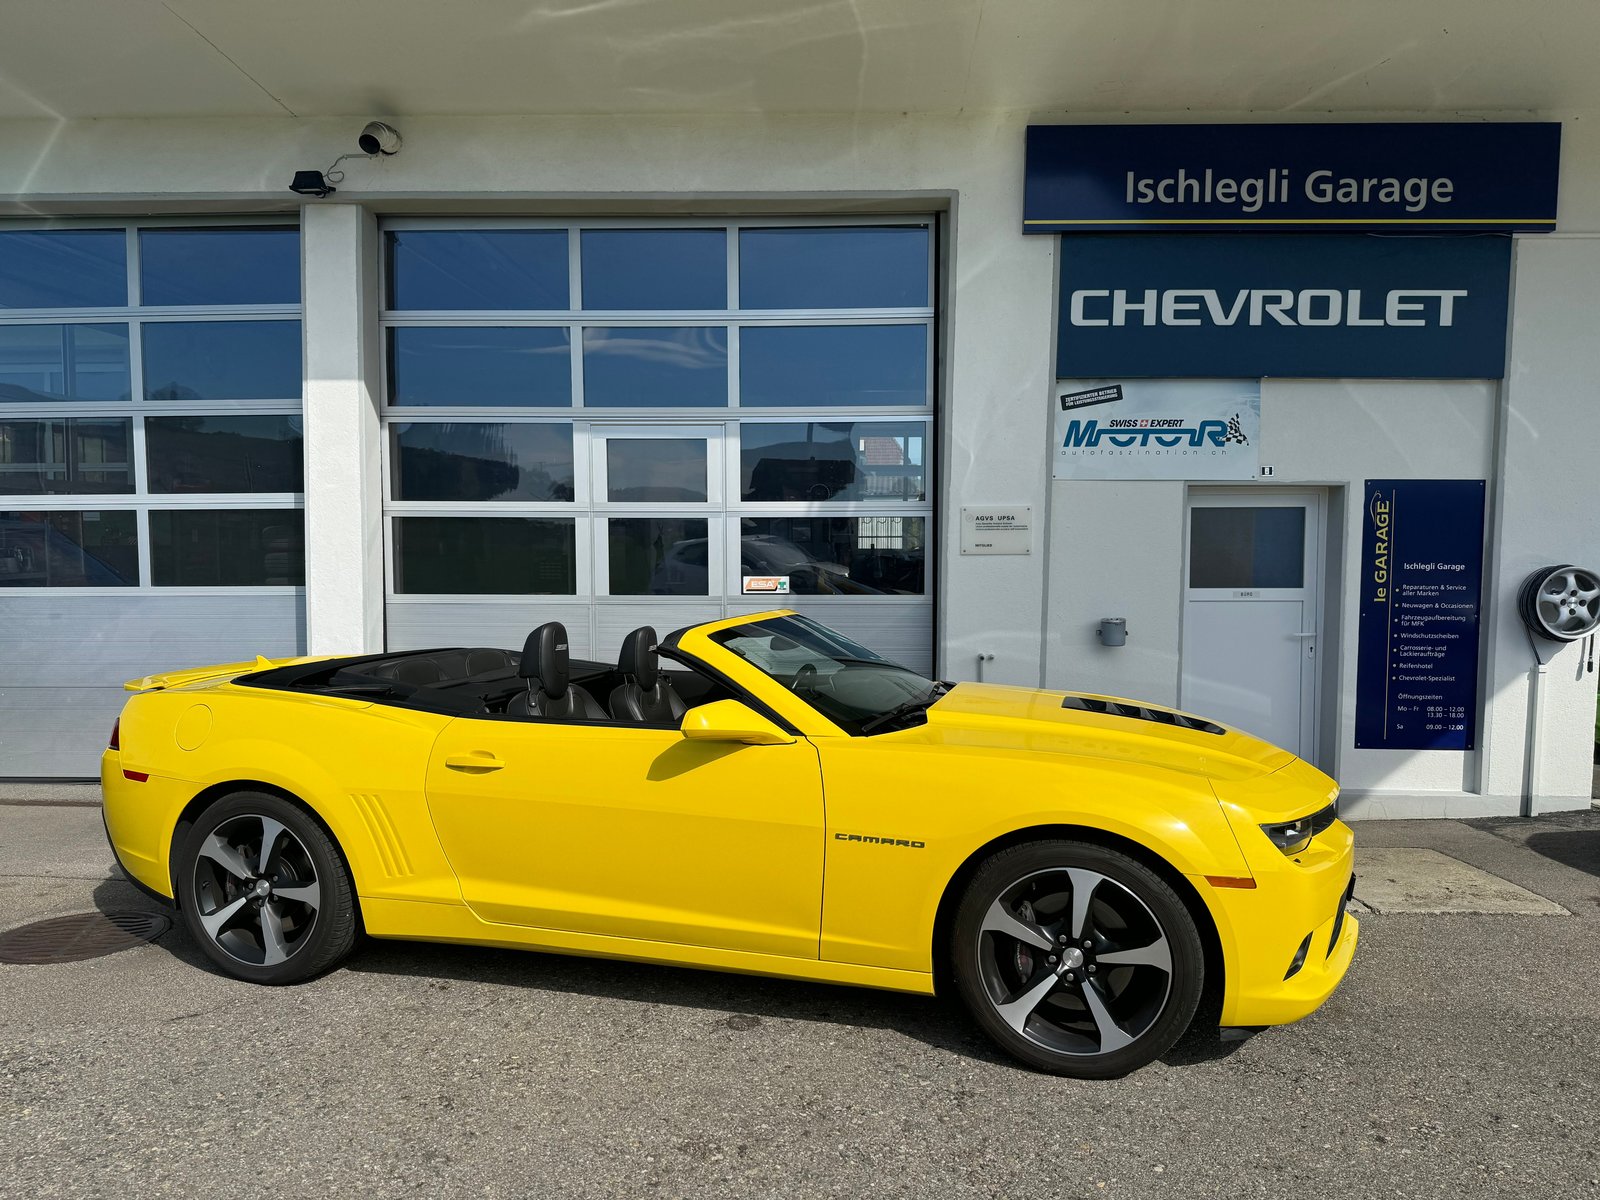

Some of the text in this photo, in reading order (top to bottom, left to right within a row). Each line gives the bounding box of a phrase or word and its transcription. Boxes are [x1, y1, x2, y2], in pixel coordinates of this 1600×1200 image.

[1126, 168, 1454, 212] Ischlegli Garage
[1070, 289, 1468, 327] CHEVROLET
[1110, 419, 1184, 427] SWISS EXPERT
[1374, 500, 1389, 602] le GARAGE
[1404, 562, 1466, 571] Ischlegli Garage
[1398, 693, 1443, 701] Öffnungszeiten
[835, 833, 925, 848] CAMARO
